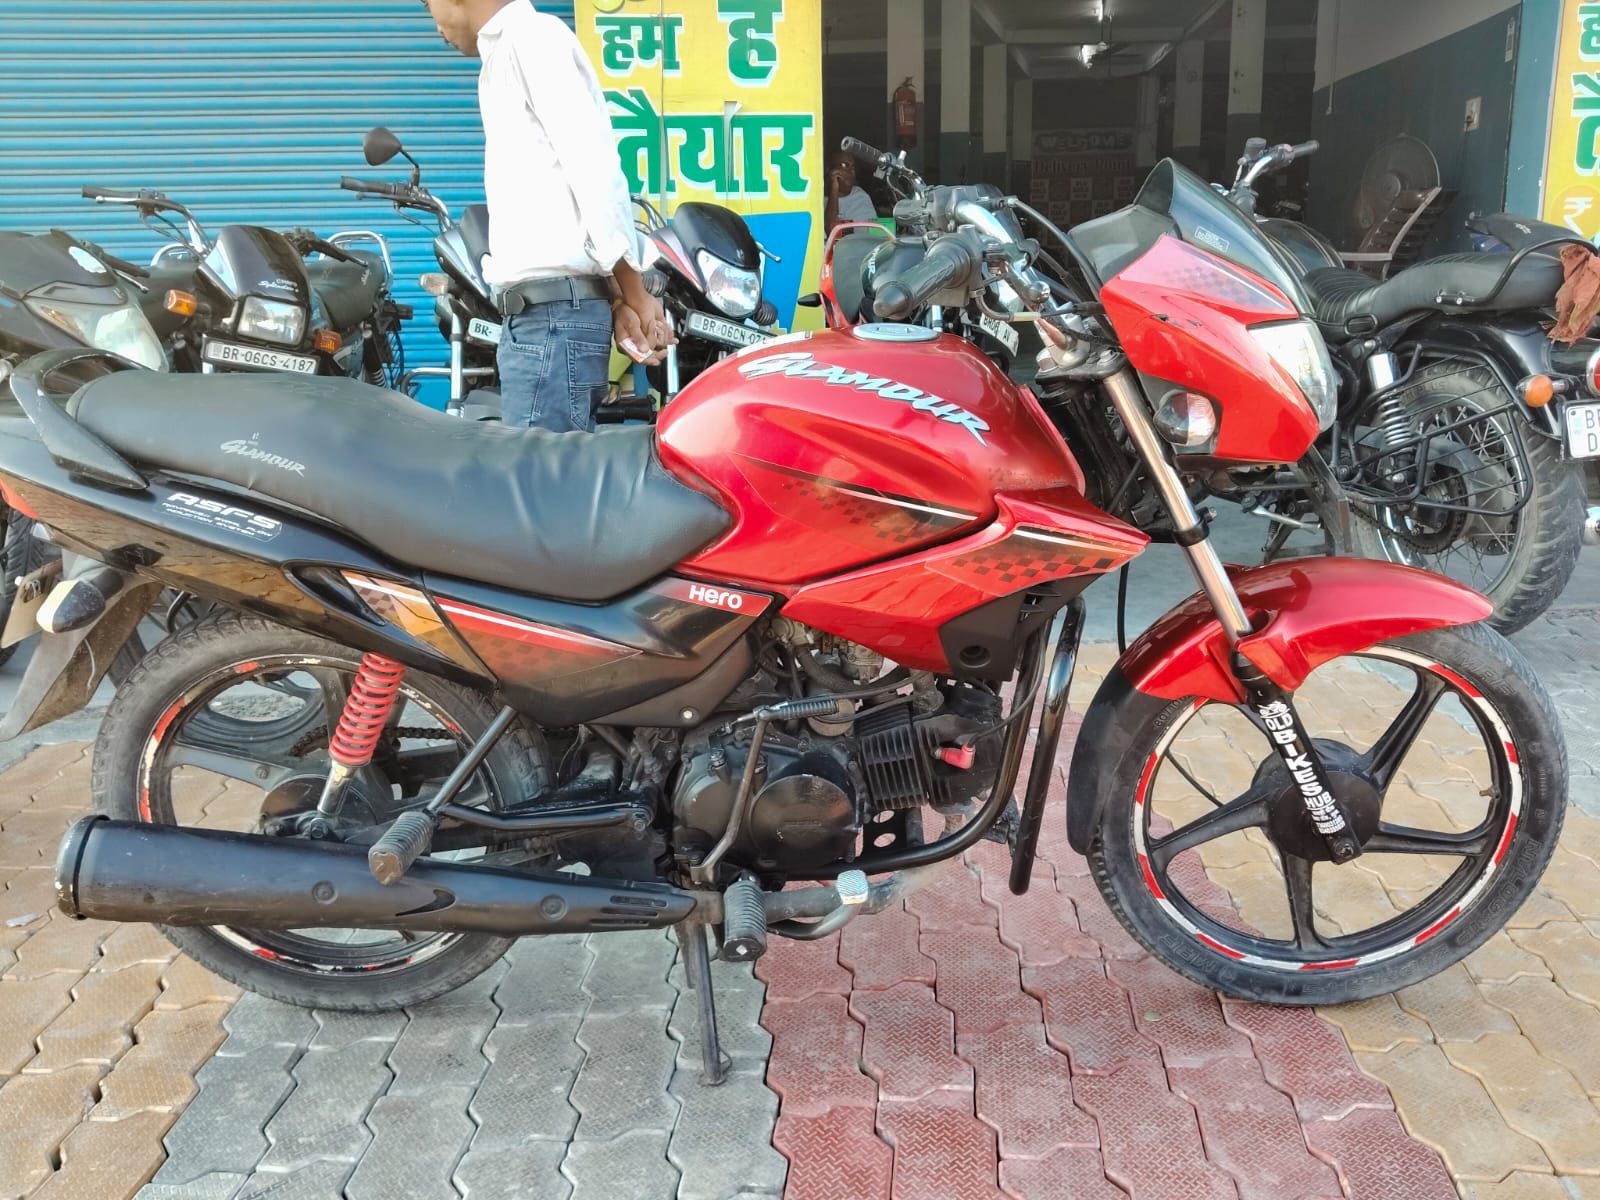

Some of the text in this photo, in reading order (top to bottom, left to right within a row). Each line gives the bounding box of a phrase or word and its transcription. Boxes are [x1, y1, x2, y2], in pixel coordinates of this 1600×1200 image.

[595, 17, 683, 71] हम
[603, 89, 813, 194] तैयार
[738, 352, 990, 447] GLAMOUR
[1585, 409, 1600, 430] B
[220, 439, 306, 478] GLAMOUR
[167, 492, 281, 529] ASFS
[689, 585, 743, 609] Hero
[1265, 713, 1294, 731] OLD
[1272, 728, 1323, 797] BIKES
[1304, 792, 1333, 808] HUB
